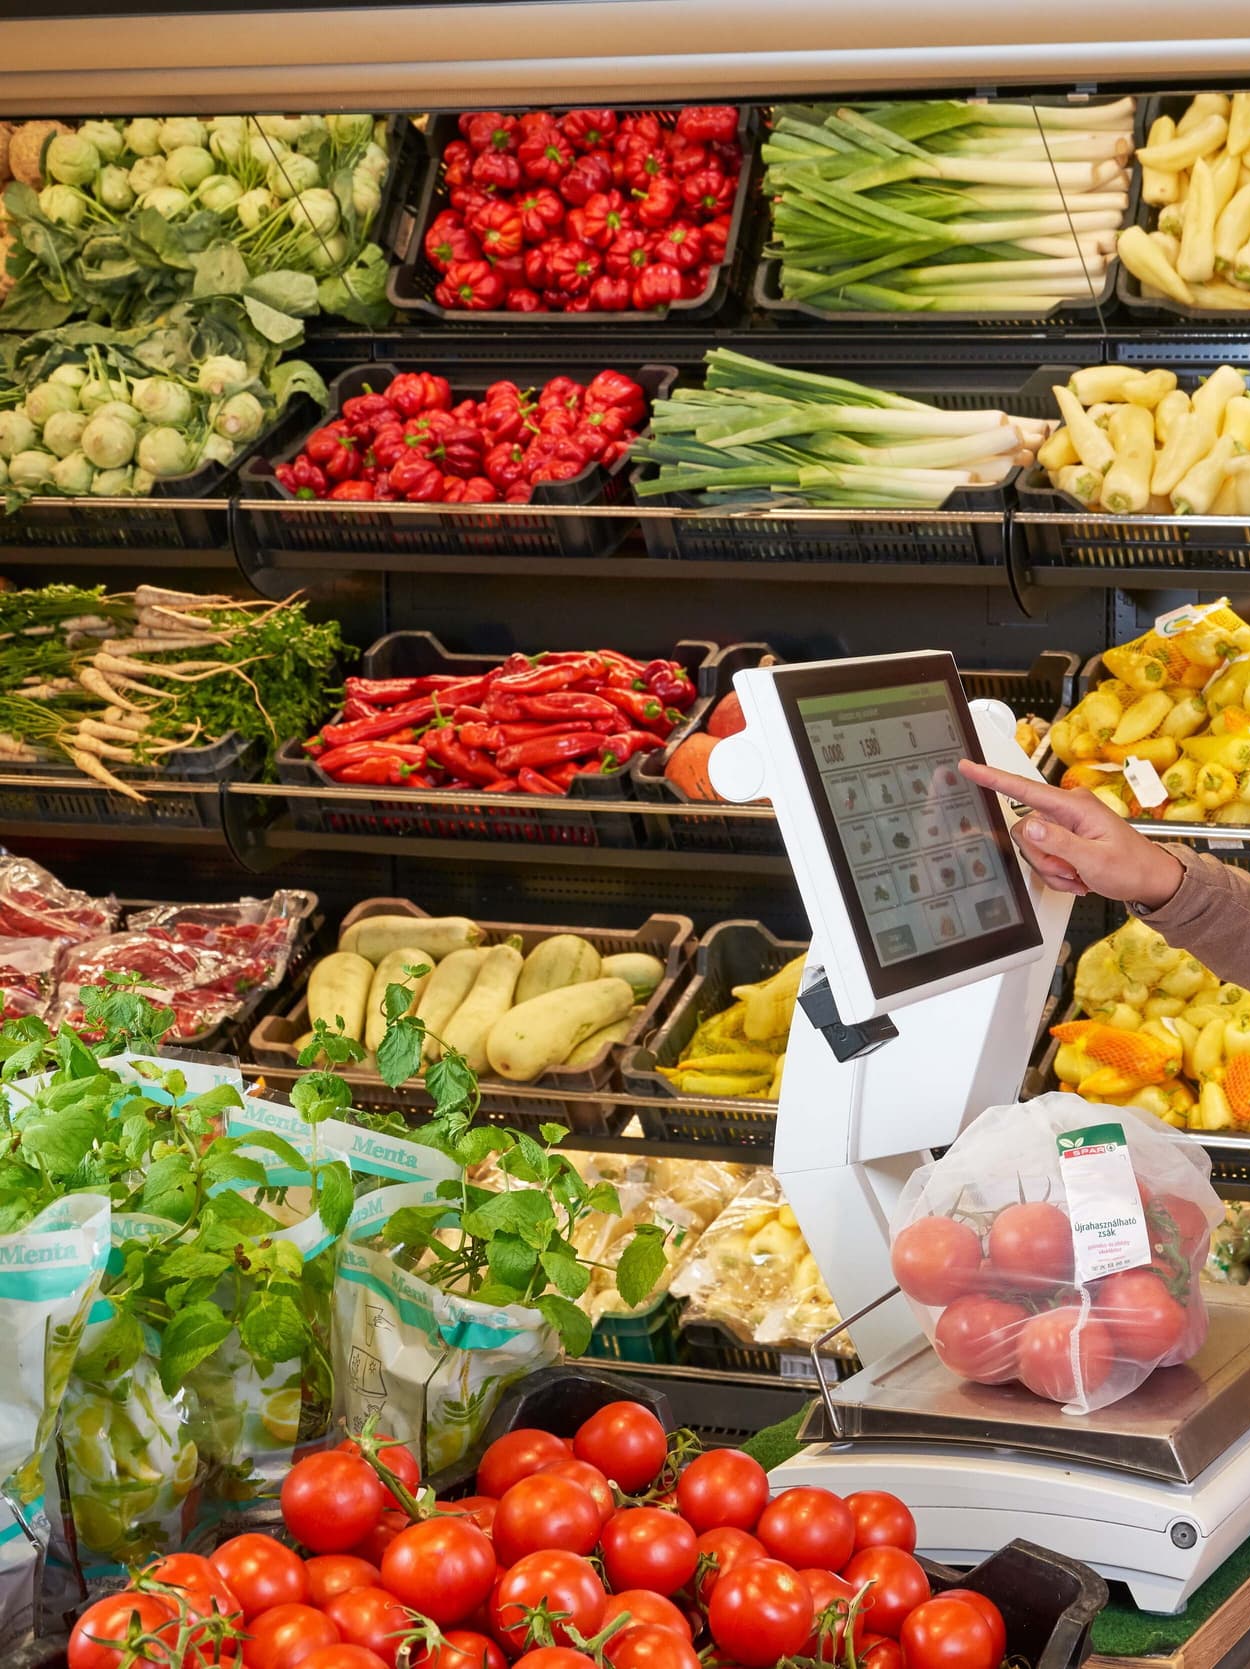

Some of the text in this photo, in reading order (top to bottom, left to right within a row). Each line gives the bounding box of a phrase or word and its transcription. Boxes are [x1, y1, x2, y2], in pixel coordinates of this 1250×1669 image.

[244, 1104, 311, 1137] Menta
[352, 1135, 418, 1169] Menta
[1074, 1217, 1137, 1233] Újrahasználható
[1098, 1228, 1117, 1238] zsák
[0, 1241, 78, 1265] Menta
[391, 1270, 428, 1304] Ment
